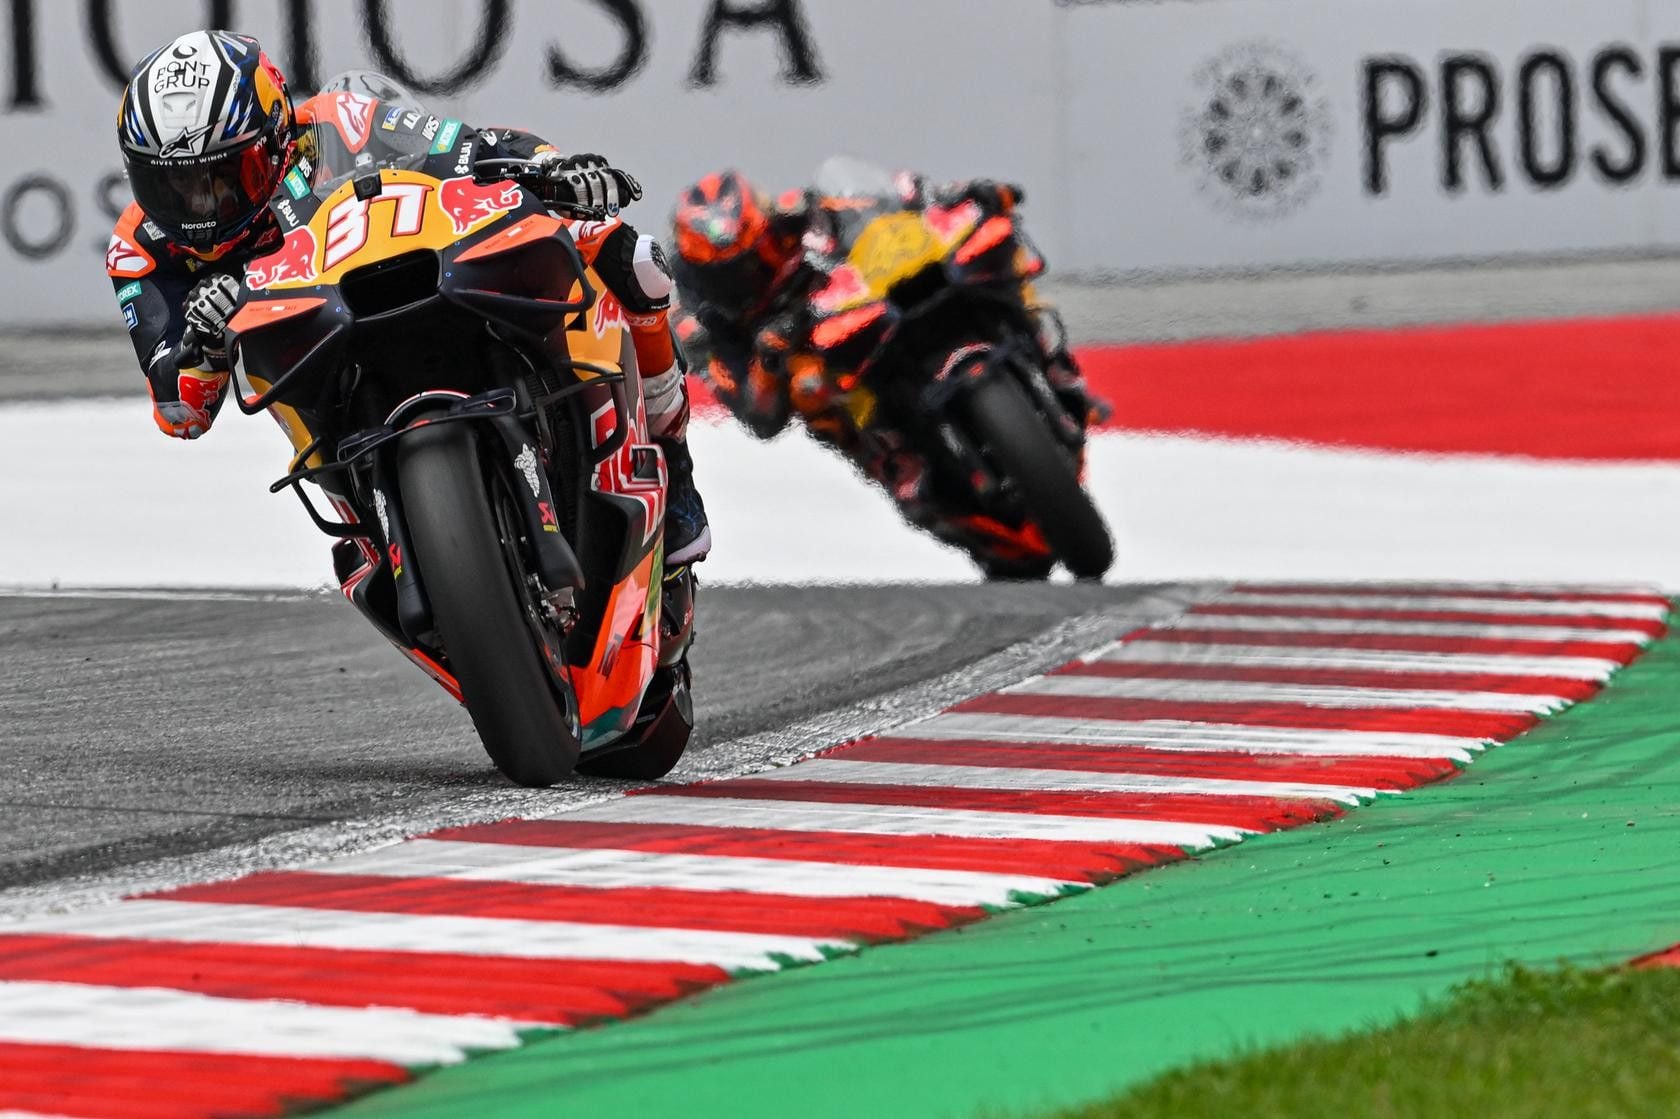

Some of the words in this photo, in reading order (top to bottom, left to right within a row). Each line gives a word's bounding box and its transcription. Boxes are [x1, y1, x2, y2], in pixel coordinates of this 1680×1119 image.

[157, 60, 211, 80] FONT
[154, 74, 210, 94] GRUP
[181, 220, 217, 231] Norauto
[322, 182, 435, 273] 37
